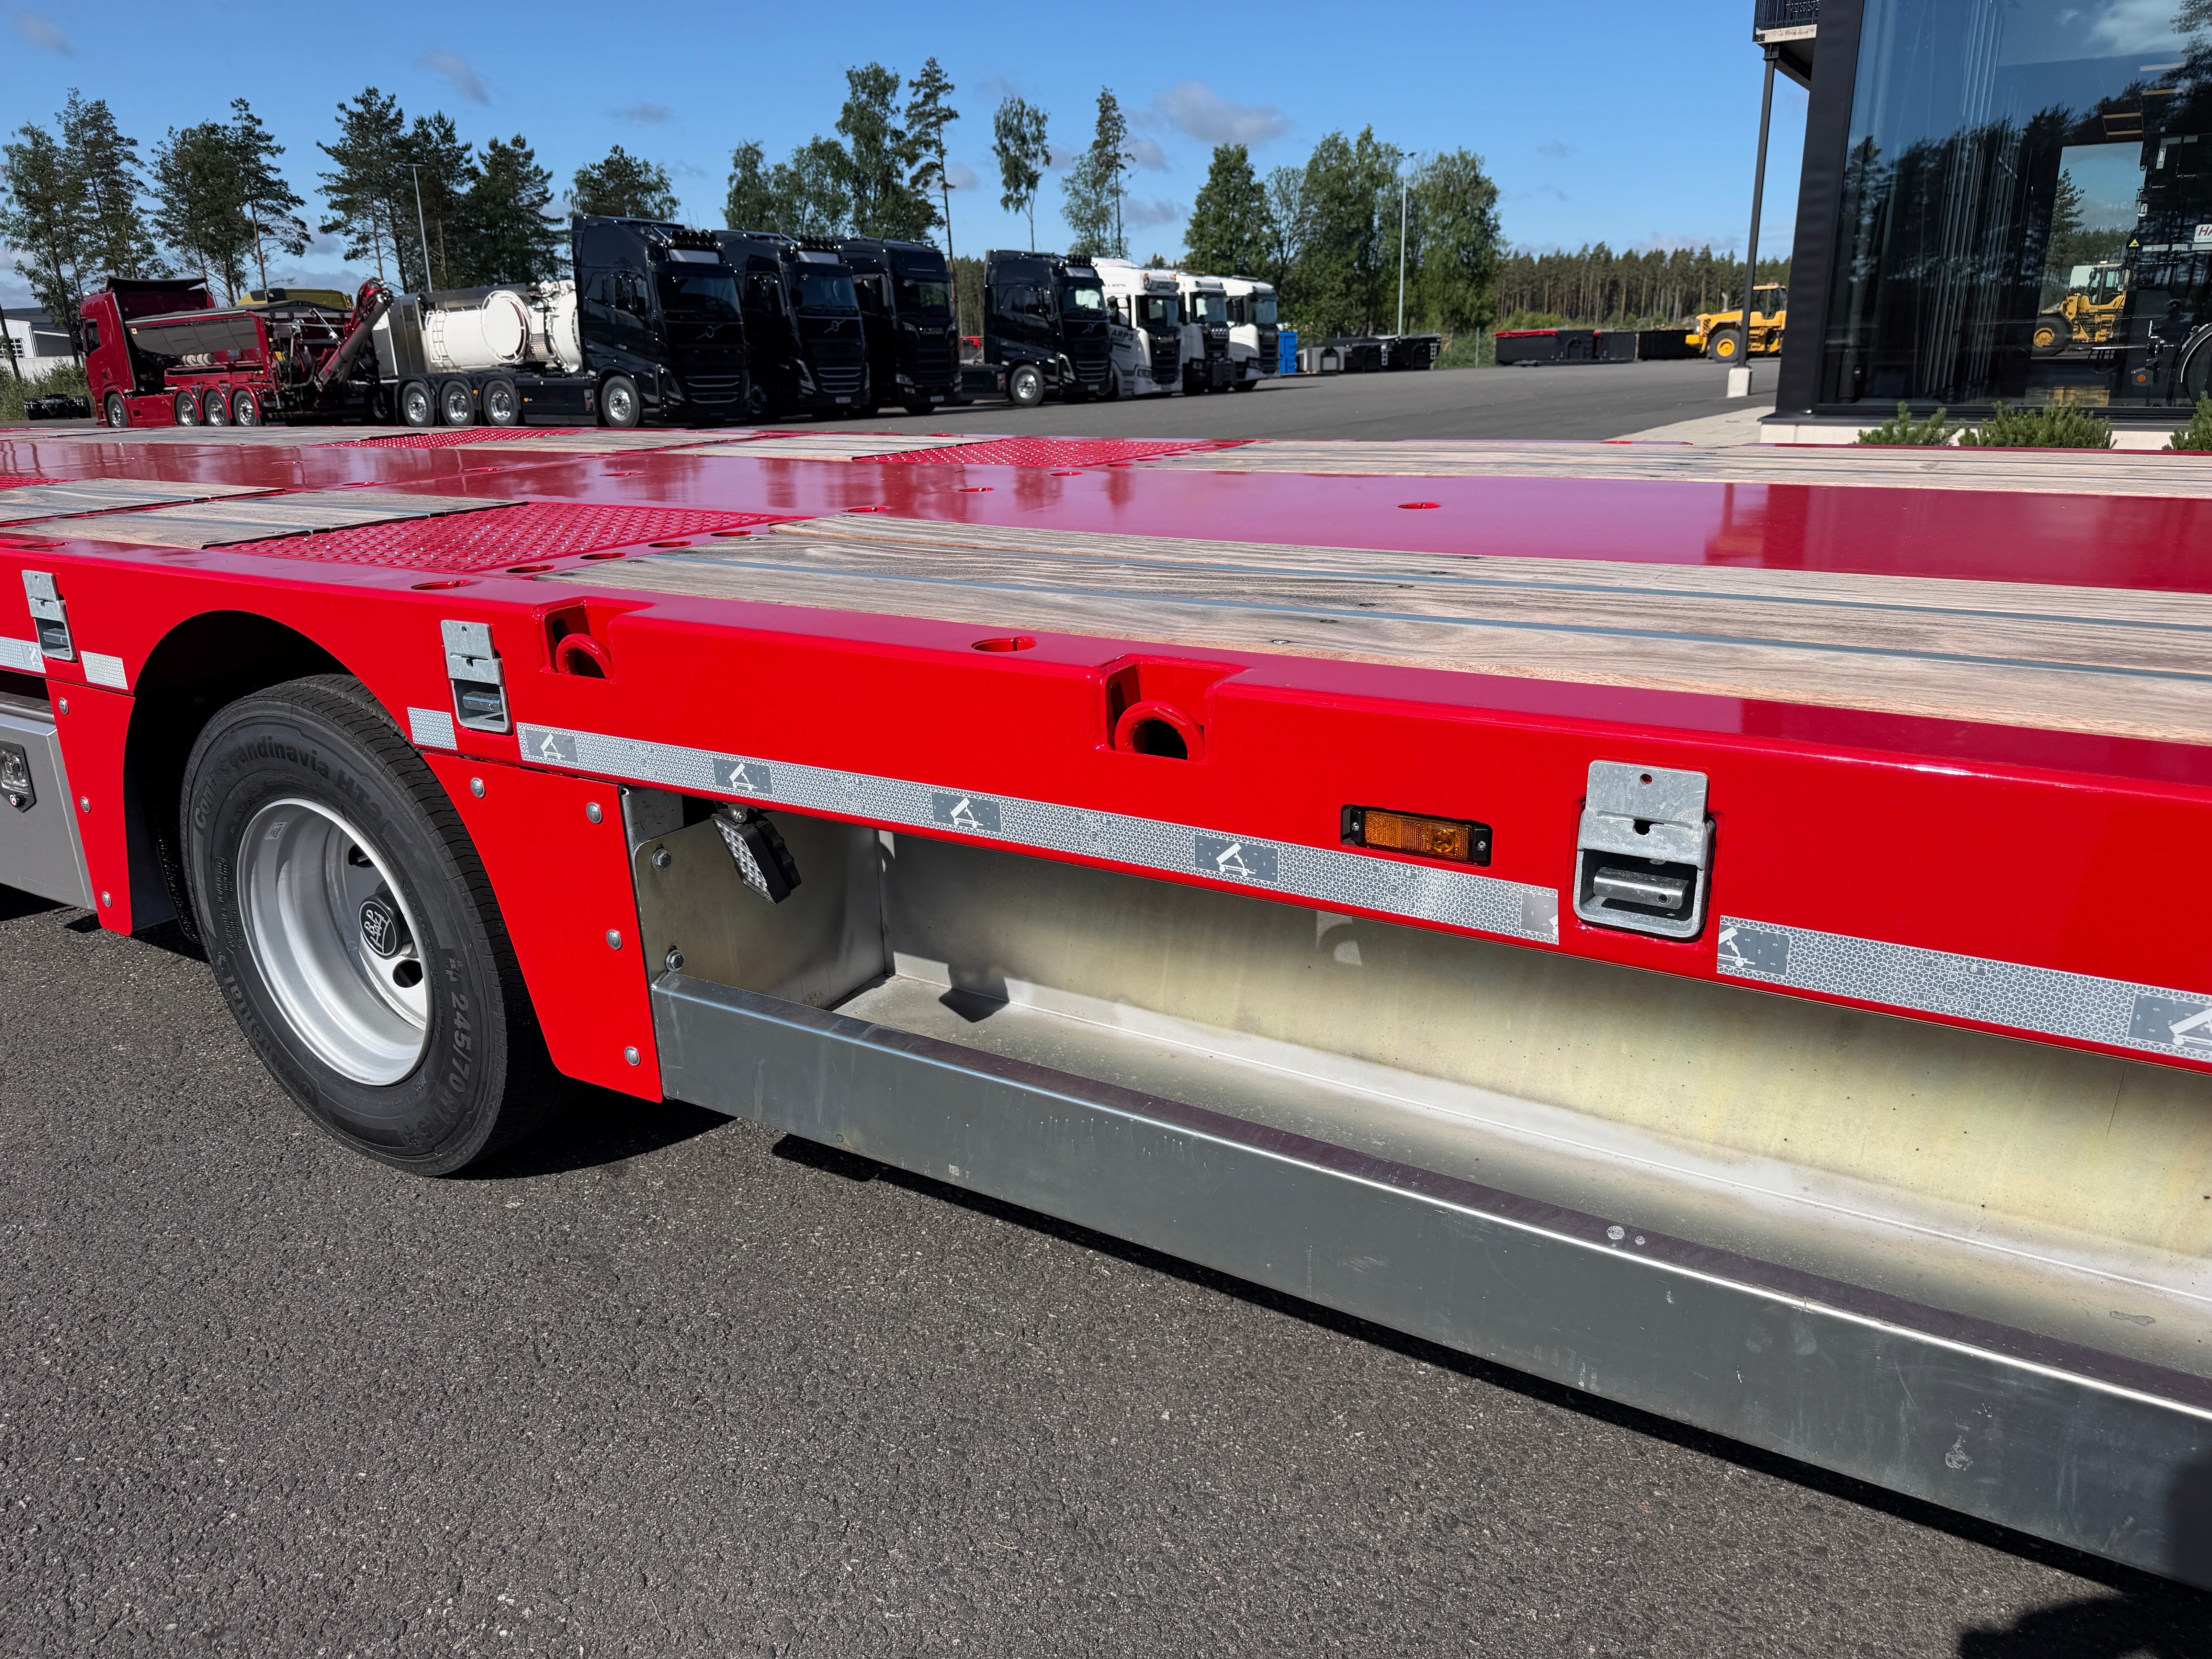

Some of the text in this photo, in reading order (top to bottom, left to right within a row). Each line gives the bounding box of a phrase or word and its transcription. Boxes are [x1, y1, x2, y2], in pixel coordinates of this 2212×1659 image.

[219, 736, 330, 780] Scandinavia
[1938, 996, 1975, 1010] R-000001
[224, 974, 318, 1107] Cnental
[449, 991, 473, 1092] 245/70
